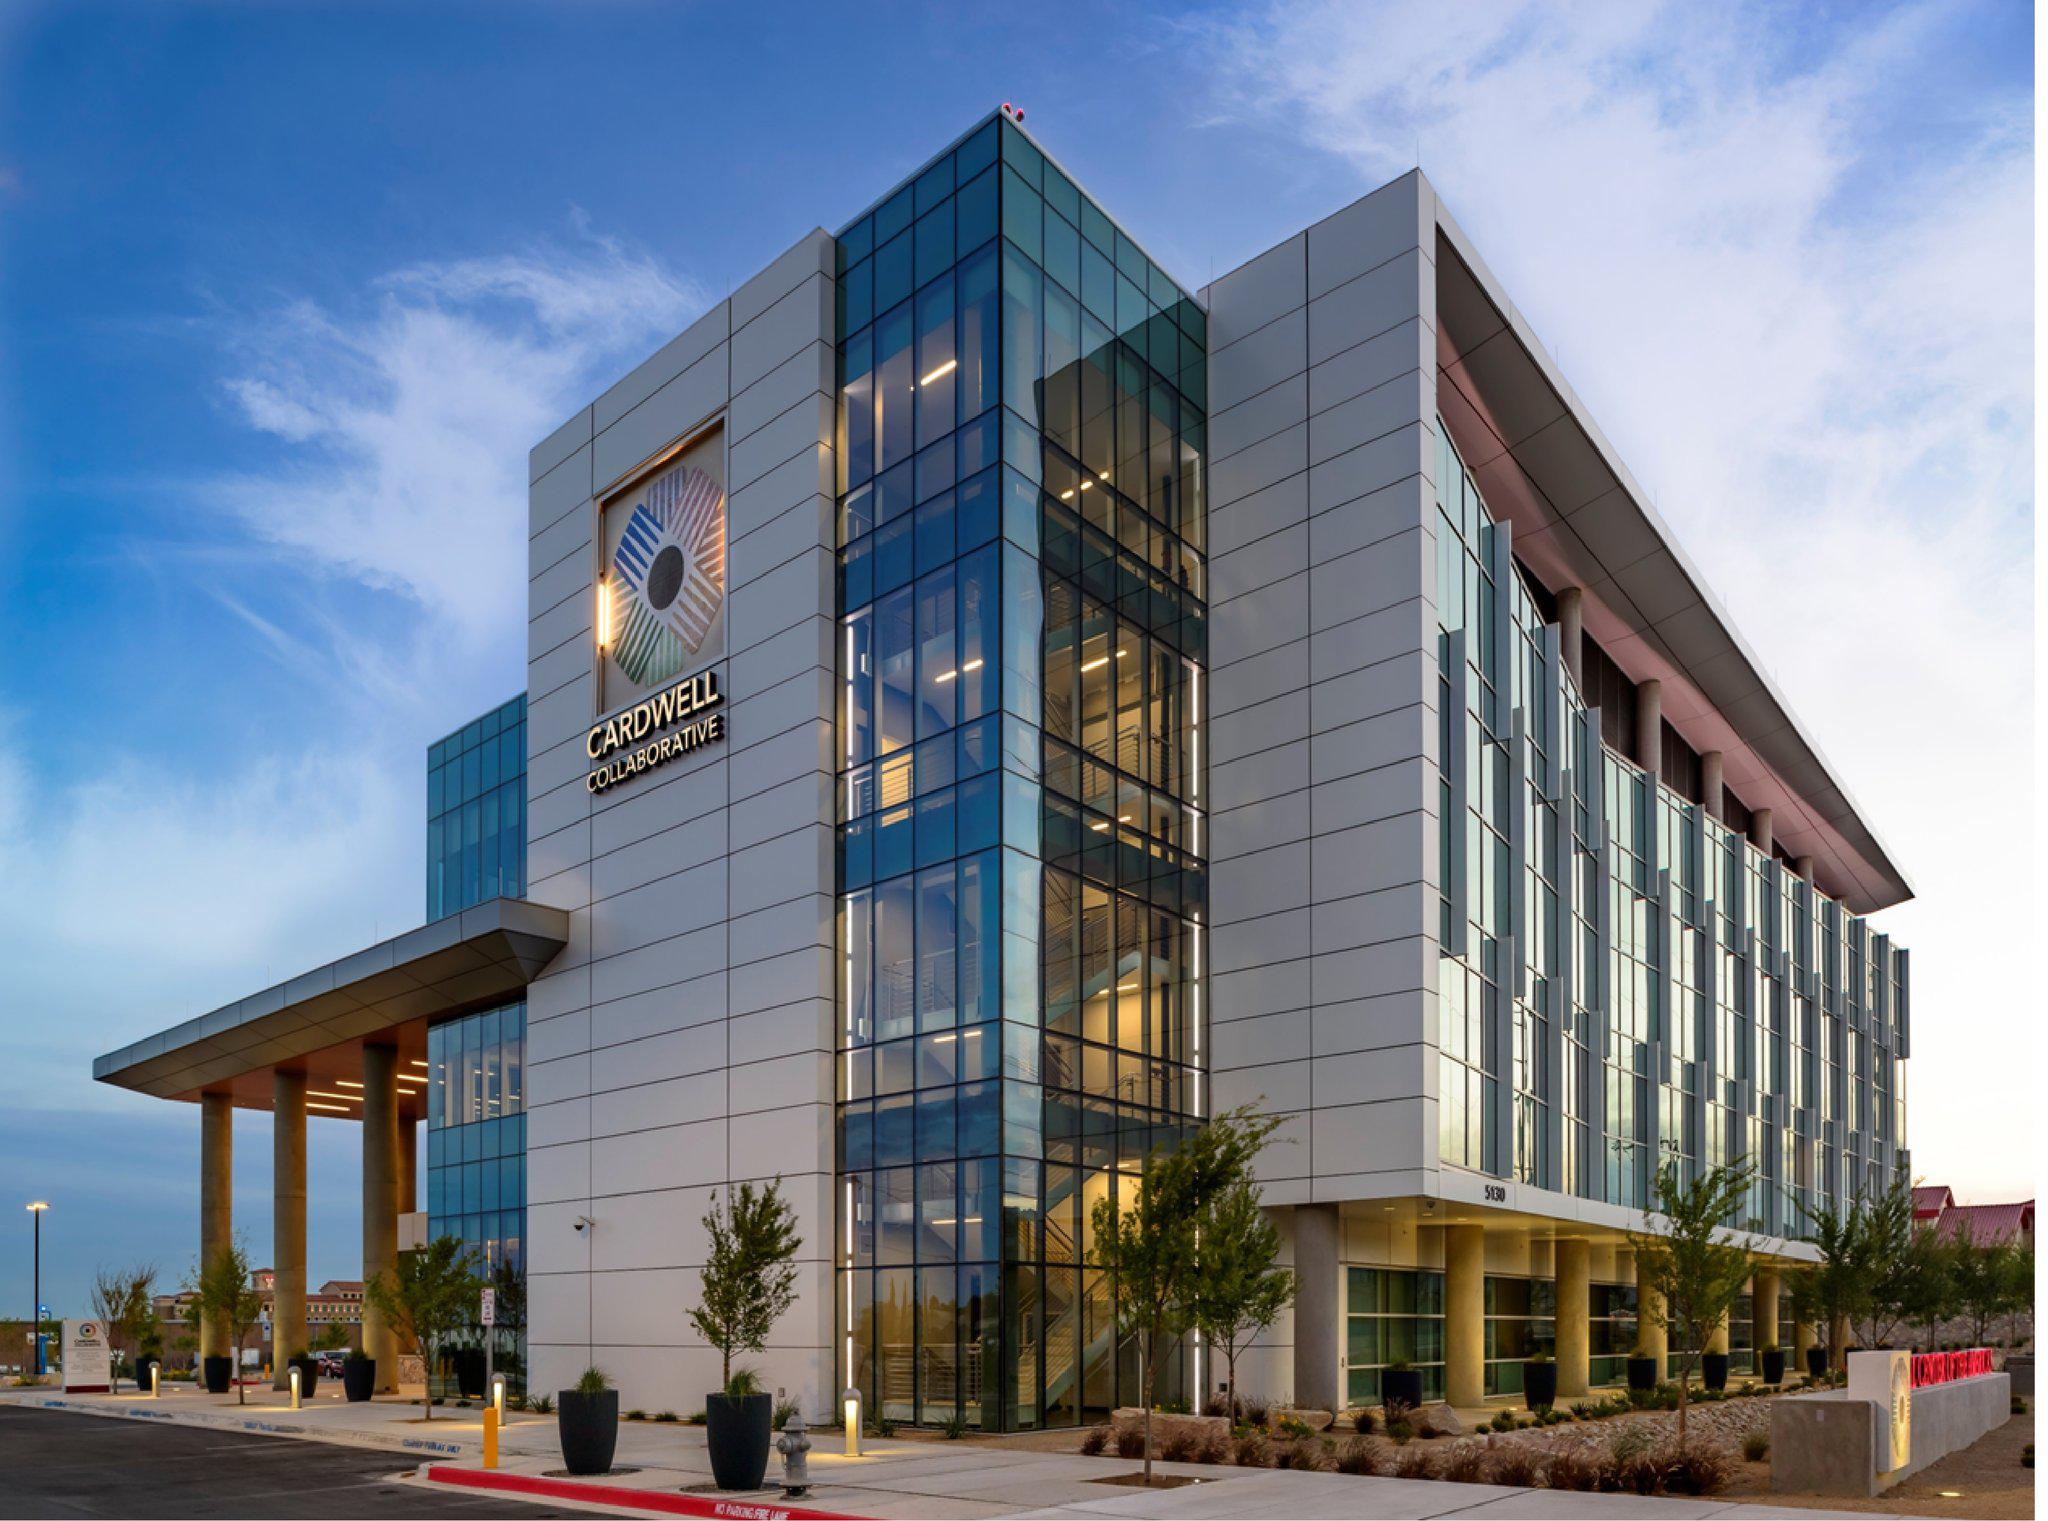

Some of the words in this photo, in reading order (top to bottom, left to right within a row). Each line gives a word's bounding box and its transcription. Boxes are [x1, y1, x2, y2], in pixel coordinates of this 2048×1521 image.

[586, 671, 720, 759] CARDWELL
[586, 714, 720, 792] COLLABORATIVE
[1484, 1184, 1506, 1202] 5130
[714, 1503, 725, 1515] NO
